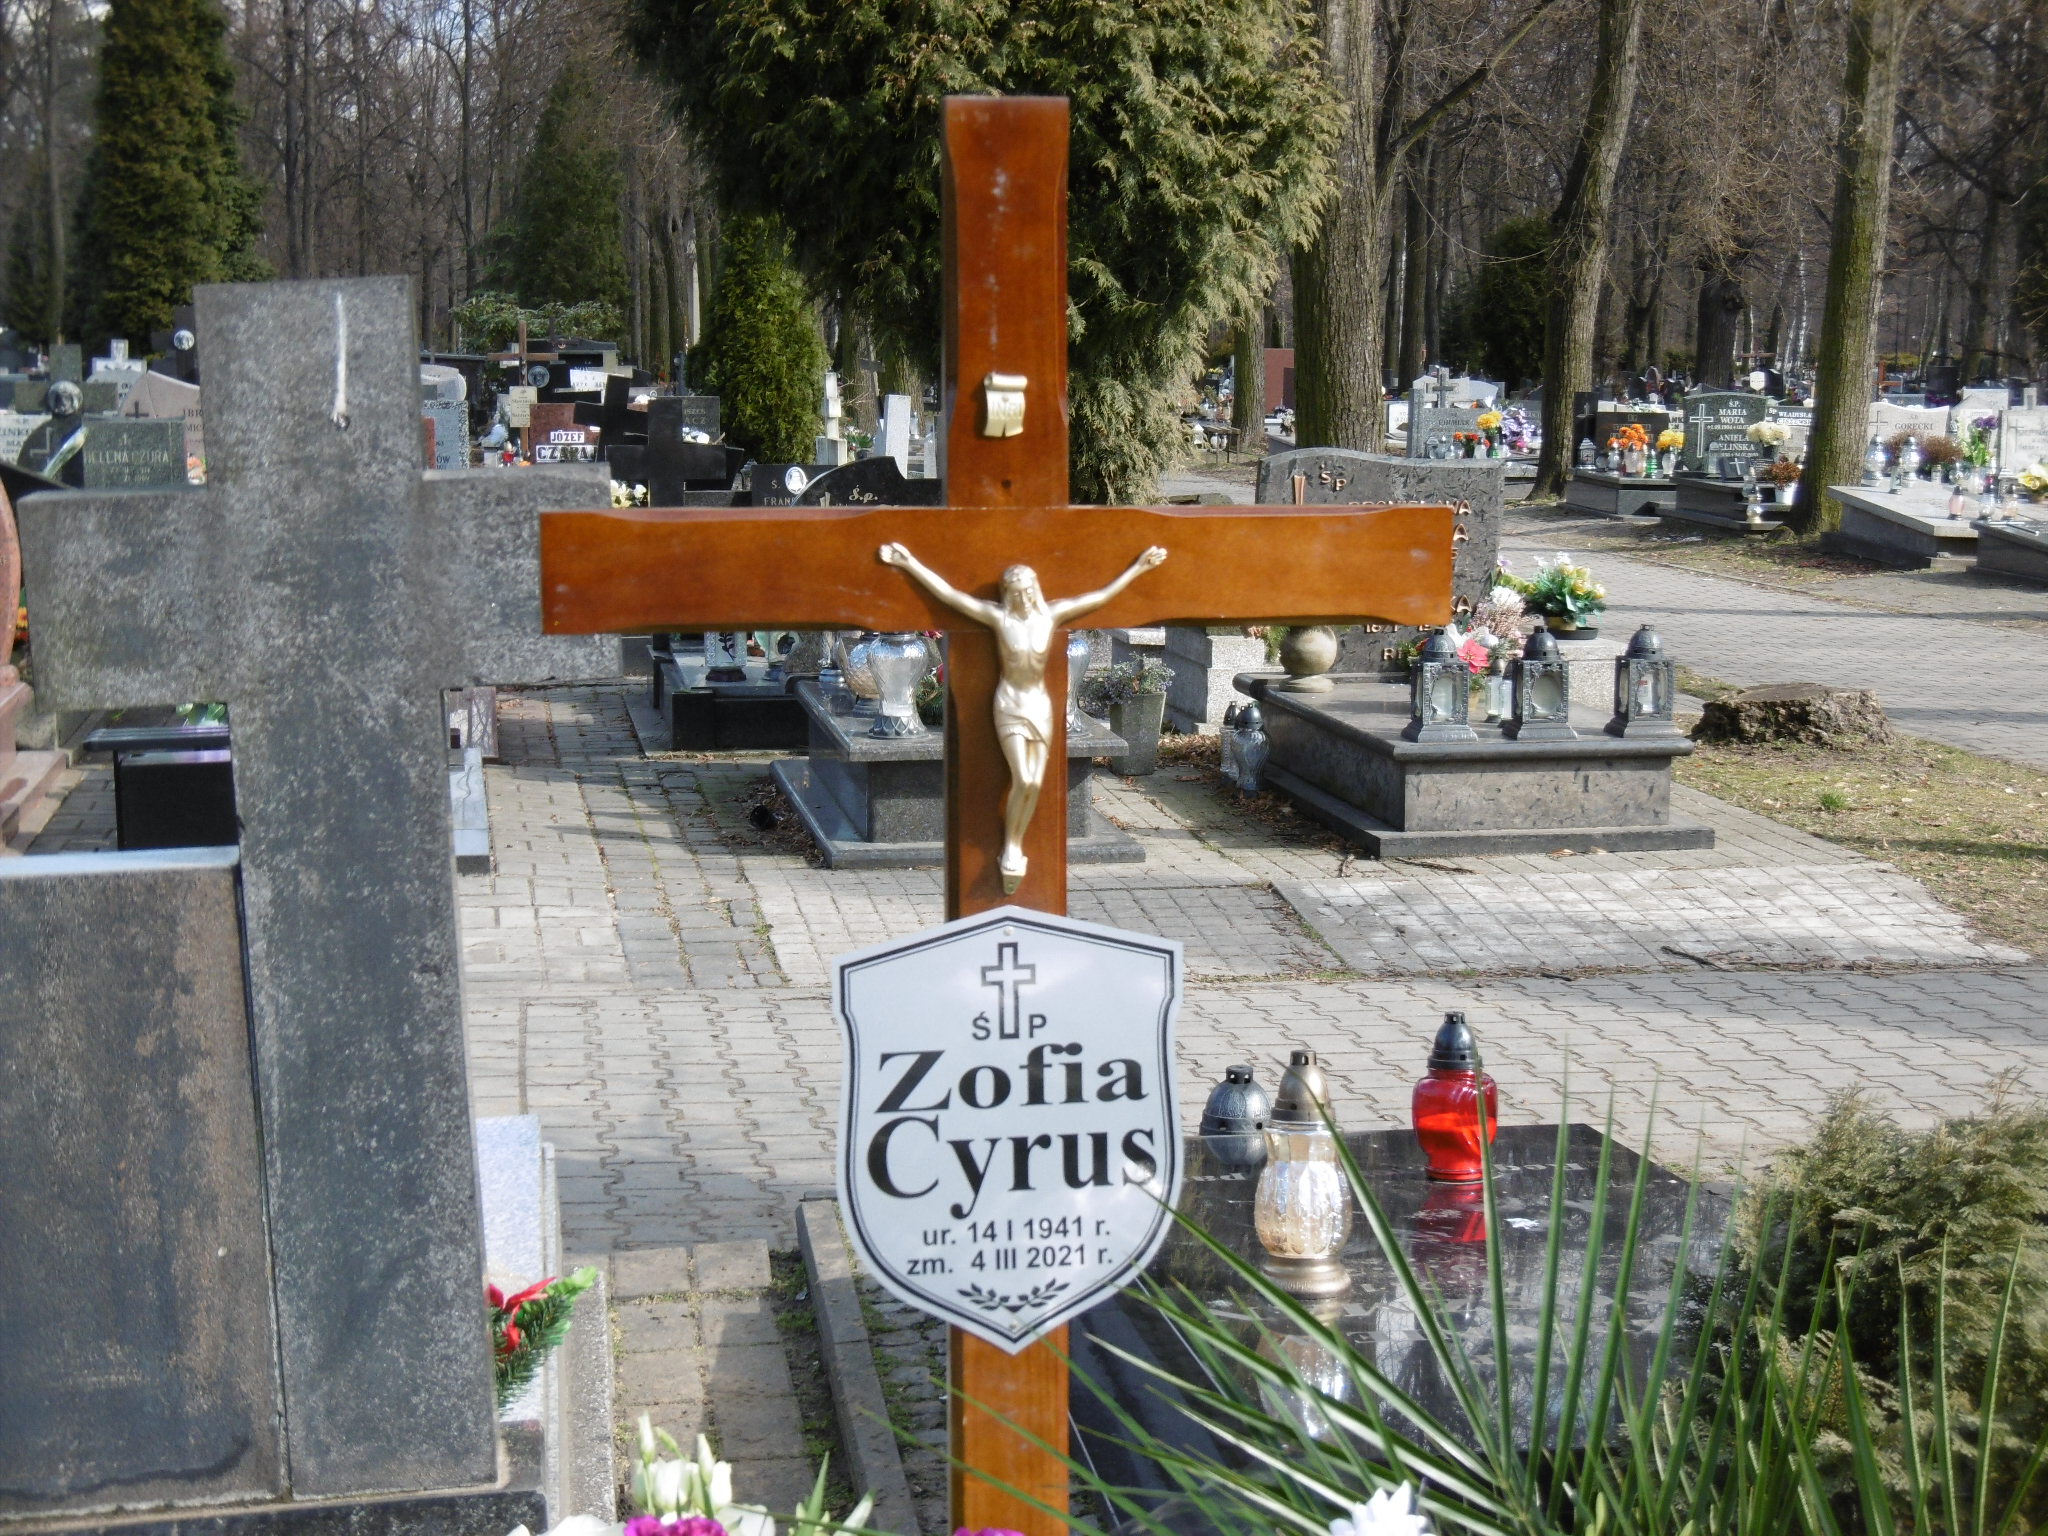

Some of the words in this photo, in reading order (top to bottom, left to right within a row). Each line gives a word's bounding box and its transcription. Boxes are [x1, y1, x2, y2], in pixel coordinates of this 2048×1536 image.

[552, 430, 584, 442] JÓZEF
[1719, 434, 1750, 442] ANIELA
[763, 497, 795, 506] FRAN
[1028, 1014, 1047, 1039] P
[874, 1042, 1149, 1114] Zofia
[867, 1114, 1157, 1219] Cyrus
[923, 1228, 956, 1246] ur.
[967, 1221, 998, 1244] 14
[1023, 1215, 1083, 1240] 1941
[1096, 1219, 1111, 1237] r.
[906, 1257, 954, 1276] zm.
[971, 1250, 986, 1272] 4
[995, 1248, 1017, 1271] III
[1025, 1244, 1087, 1269] 2021
[1097, 1248, 1113, 1265] r.
